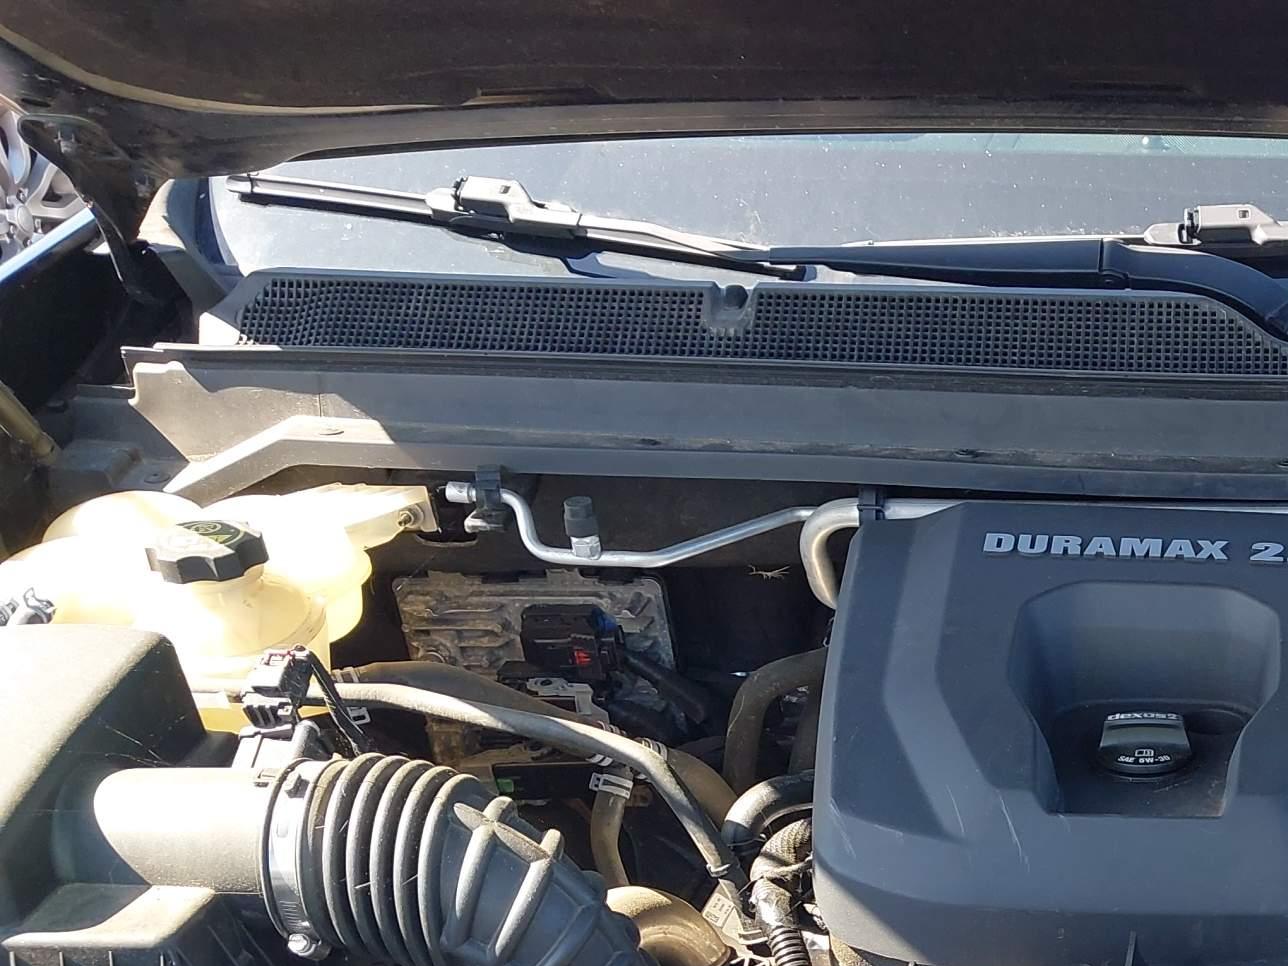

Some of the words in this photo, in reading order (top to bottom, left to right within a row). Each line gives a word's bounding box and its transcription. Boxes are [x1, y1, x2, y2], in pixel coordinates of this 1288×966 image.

[983, 532, 1229, 560] DURAMAX
[1107, 712, 1178, 721] dexos2
[1117, 755, 1136, 763] SAE
